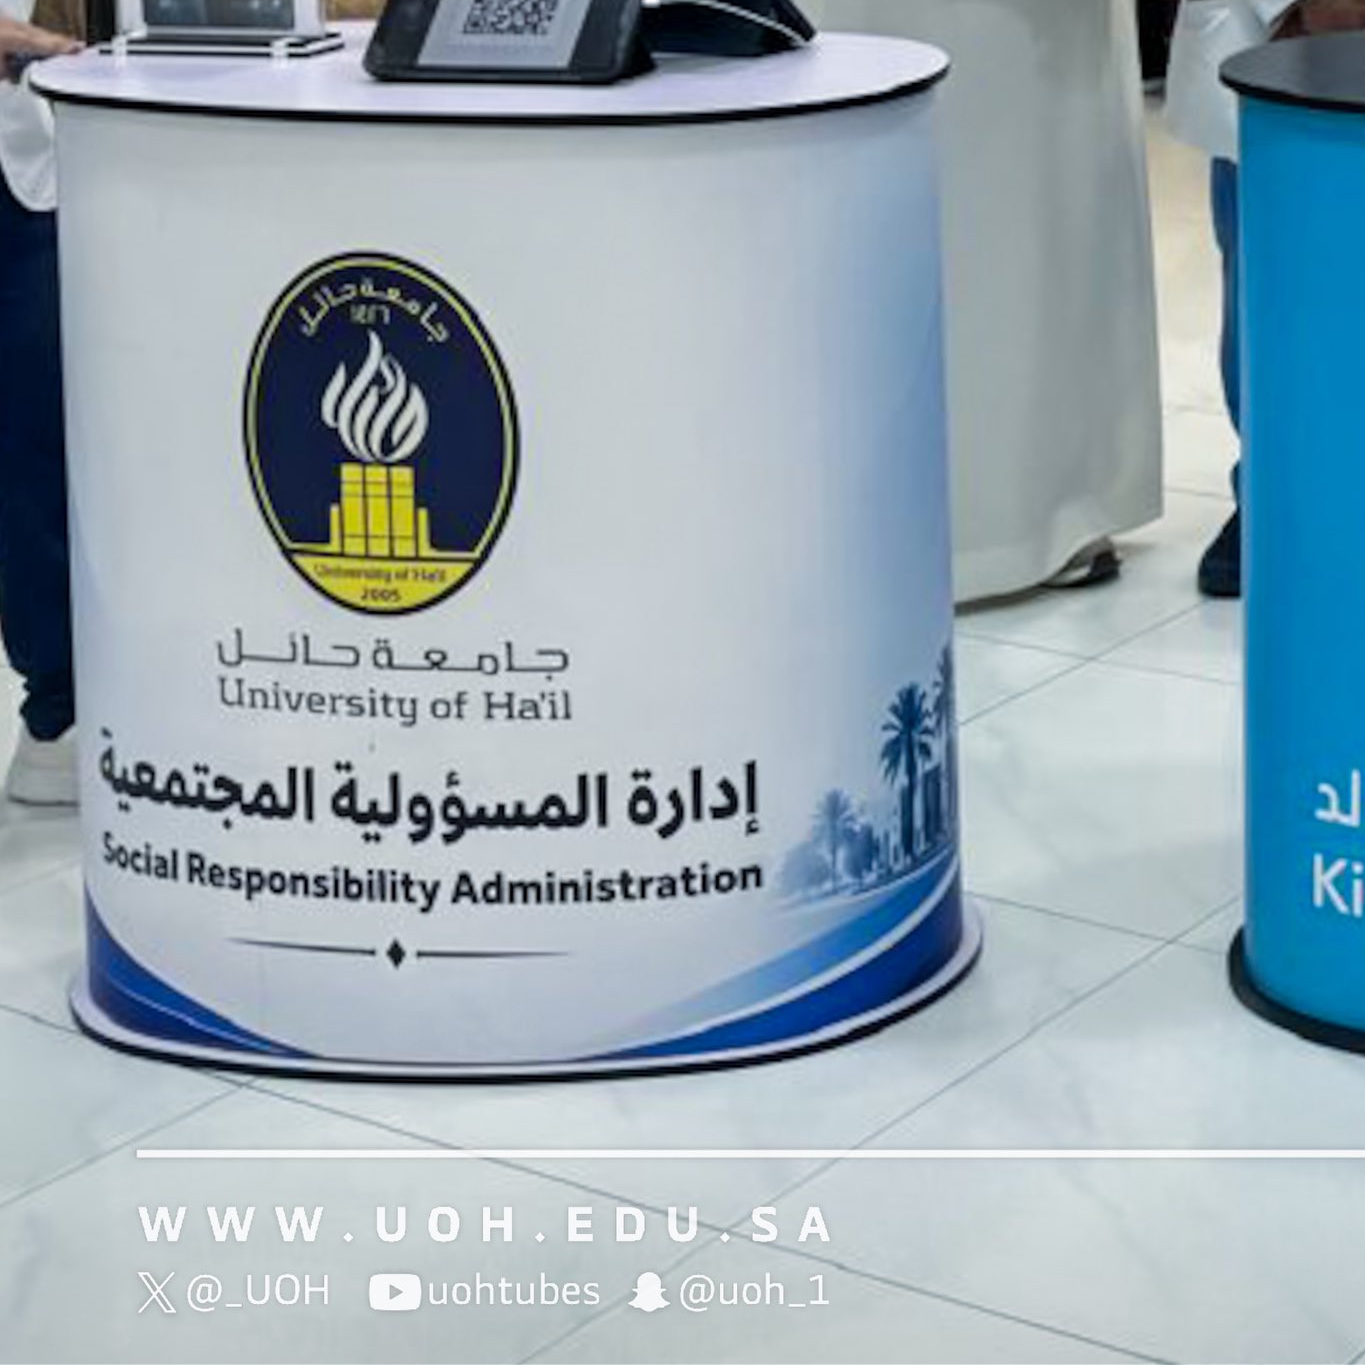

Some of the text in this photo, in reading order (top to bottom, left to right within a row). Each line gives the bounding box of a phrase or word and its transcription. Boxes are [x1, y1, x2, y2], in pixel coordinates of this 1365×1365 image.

[301, 277, 449, 343] جامعة حائل
[361, 587, 402, 602] 2005
[215, 628, 570, 683] جامعة حائل
[217, 676, 574, 729] University of Ha'il
[98, 727, 762, 852] إدارة المسؤولية المجتمعية
[102, 832, 765, 915] Social Responsibility Administration
